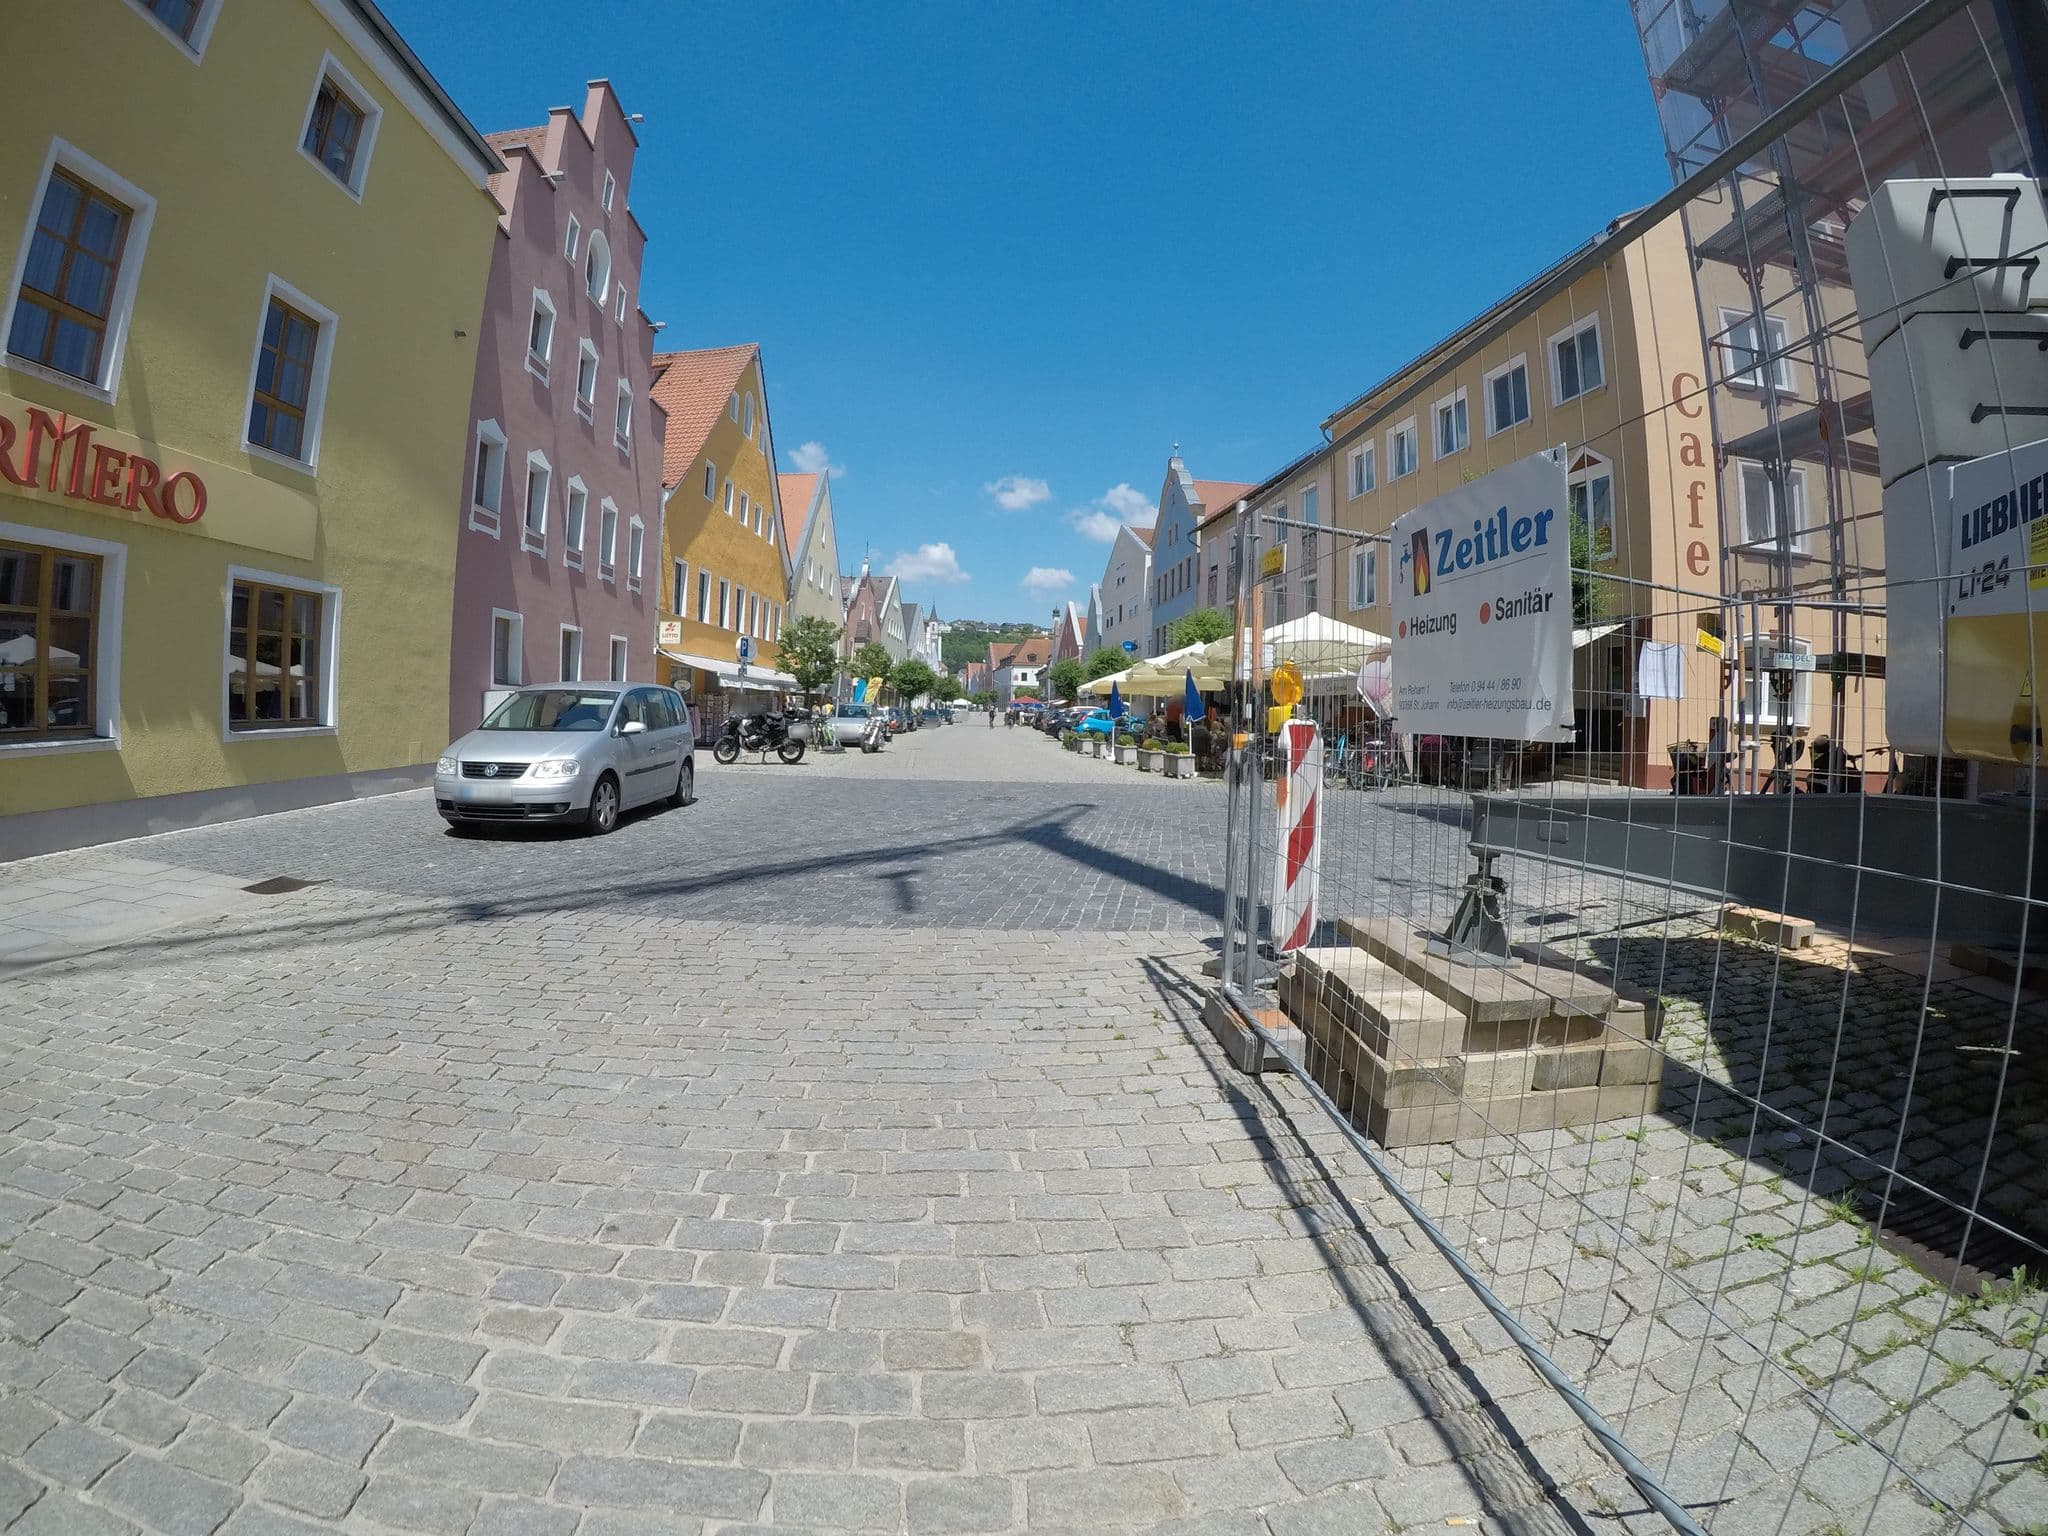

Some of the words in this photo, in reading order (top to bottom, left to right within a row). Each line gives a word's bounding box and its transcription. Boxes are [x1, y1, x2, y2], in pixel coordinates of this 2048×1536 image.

[1671, 372, 1710, 577] Cafe
[1435, 505, 1554, 577] Zeitler
[1495, 587, 1554, 621] Sanitär
[1410, 612, 1457, 637] Heizung
[1450, 681, 1470, 693] Telefon
[1447, 698, 1552, 712] info@zeitler-heizungsbau.de
